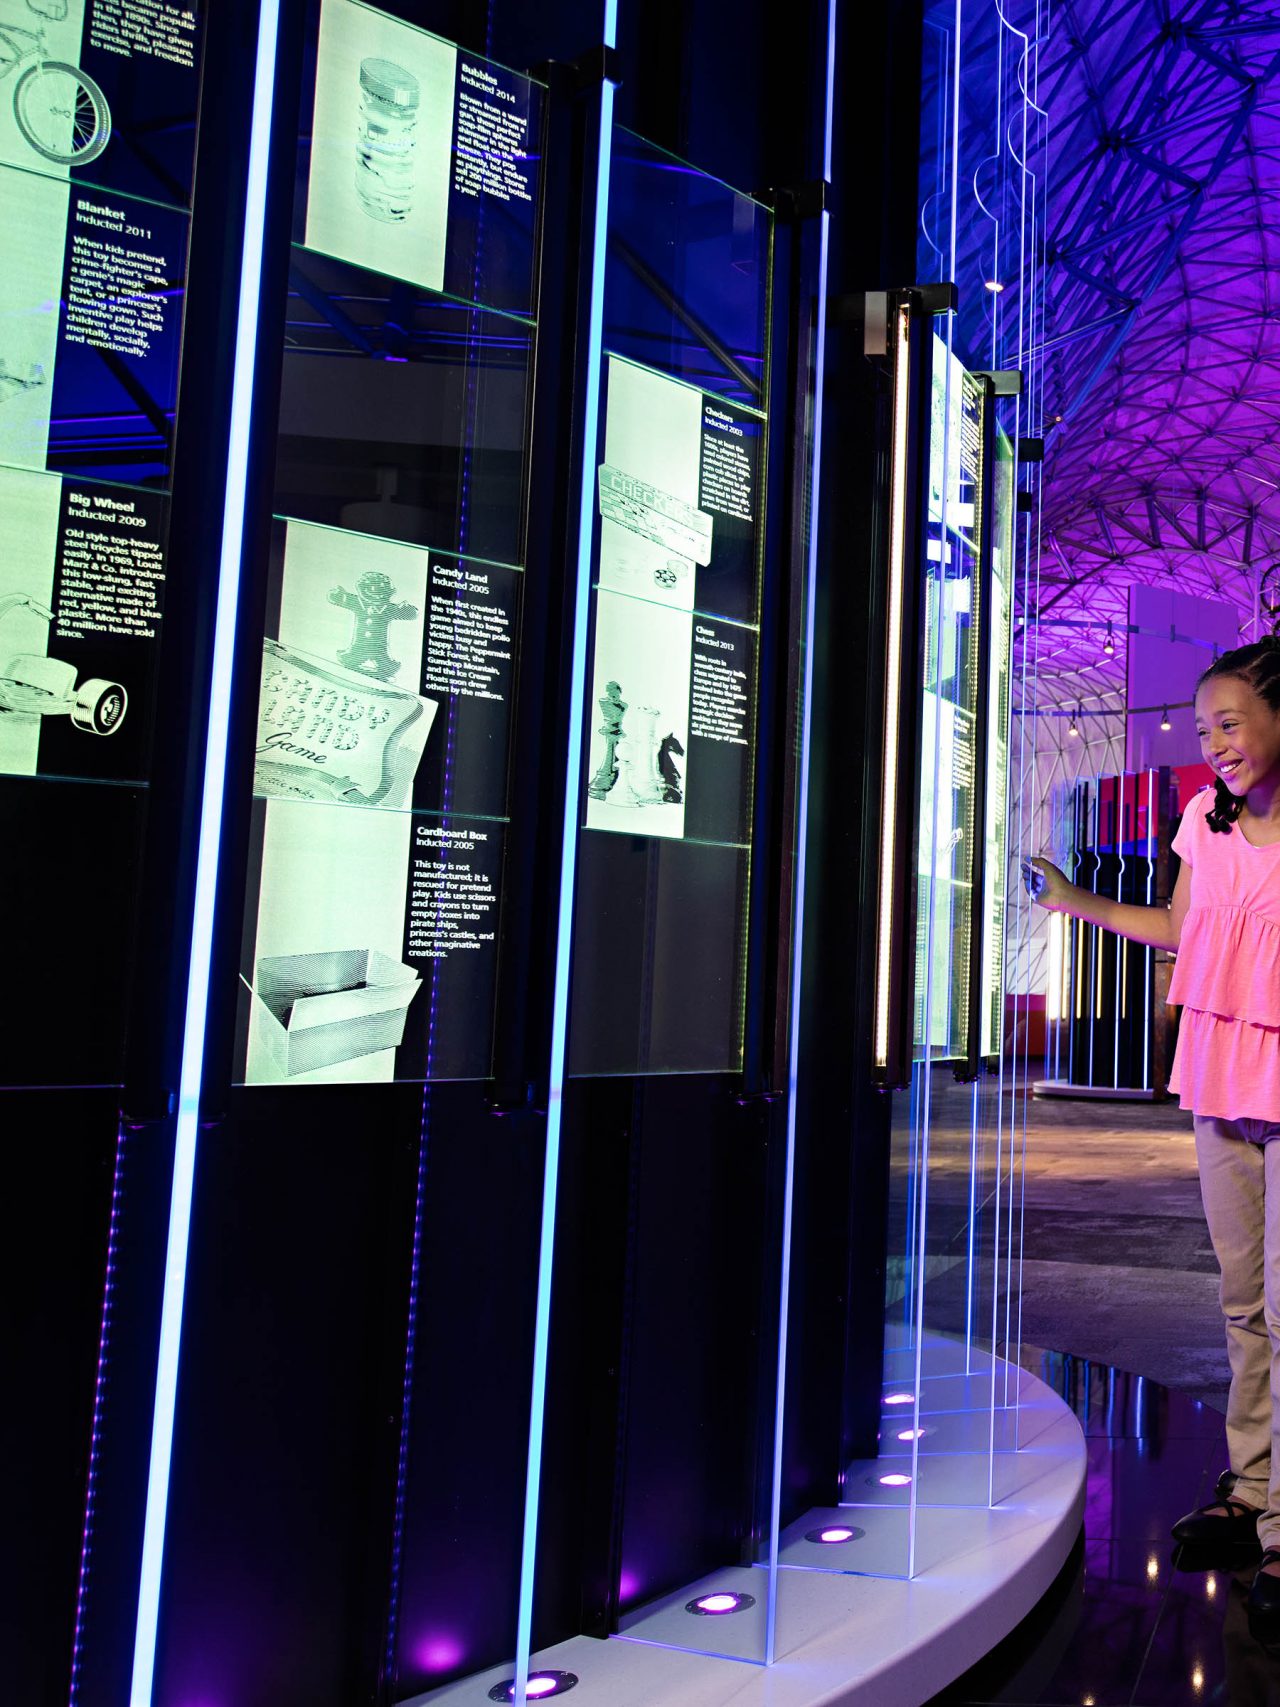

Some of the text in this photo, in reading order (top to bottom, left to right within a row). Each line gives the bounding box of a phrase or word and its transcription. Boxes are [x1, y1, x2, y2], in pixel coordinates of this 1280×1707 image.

[121, 1, 197, 30] became popular
[165, 4, 180, 16] for
[461, 63, 498, 86] Bubbles
[461, 74, 515, 103] Inducted 2014
[77, 200, 125, 221] Blanket
[76, 212, 151, 239] Inducted 2011
[73, 236, 167, 266] When kids pretend,
[73, 246, 91, 257] this
[93, 251, 109, 262] toy
[111, 254, 153, 272] becomes
[72, 257, 168, 286] crime-fighter's cape,
[79, 268, 115, 282] genie's
[116, 277, 145, 289] magic
[69, 284, 93, 297] tent,
[95, 291, 107, 299] or
[117, 296, 161, 312] princess's
[70, 276, 168, 304] carpet, an explorer's
[68, 303, 163, 331] inventive play helps
[69, 293, 164, 322] flowing gown. Such
[67, 313, 148, 338] children develop
[65, 334, 147, 357] and emotionally.
[66, 324, 150, 349] mentally, socially,
[69, 493, 135, 513] Big Wheel
[68, 506, 147, 527] Inducted 2009
[64, 539, 163, 560] steel tricycles tipped
[65, 529, 159, 551] Old style top-heavy
[63, 550, 162, 570] easily. In 1969, Louis
[63, 558, 89, 569] Marx
[91, 562, 99, 571] &
[101, 564, 117, 573] Co.
[62, 568, 156, 590] this low-slung, fast,
[433, 565, 488, 584] Candy Land
[432, 576, 490, 595] Inducted 2005
[431, 595, 506, 616] When first created in
[429, 622, 511, 642] young bedridden polio
[455, 643, 469, 652] The
[469, 645, 511, 659] Peppermint
[255, 732, 327, 764] Game
[416, 837, 475, 850] Inducted 2005
[417, 826, 487, 841] Cardboard Box
[414, 860, 432, 868] This
[432, 862, 447, 871] toy
[447, 862, 455, 870] is
[413, 881, 492, 892] rescued for pretend
[414, 871, 489, 882] manufactured; it is
[412, 889, 432, 899] play.
[434, 891, 452, 899] Kids
[467, 893, 496, 902] scissors
[411, 910, 480, 920] empty boxes into
[429, 902, 460, 910] crayons
[461, 902, 471, 910] to
[471, 903, 489, 911] turn
[409, 929, 448, 938] princess's
[449, 931, 477, 940] castles,
[410, 919, 458, 930] pirate ships,
[408, 949, 448, 957] creations.
[409, 939, 481, 950] other imaginative
